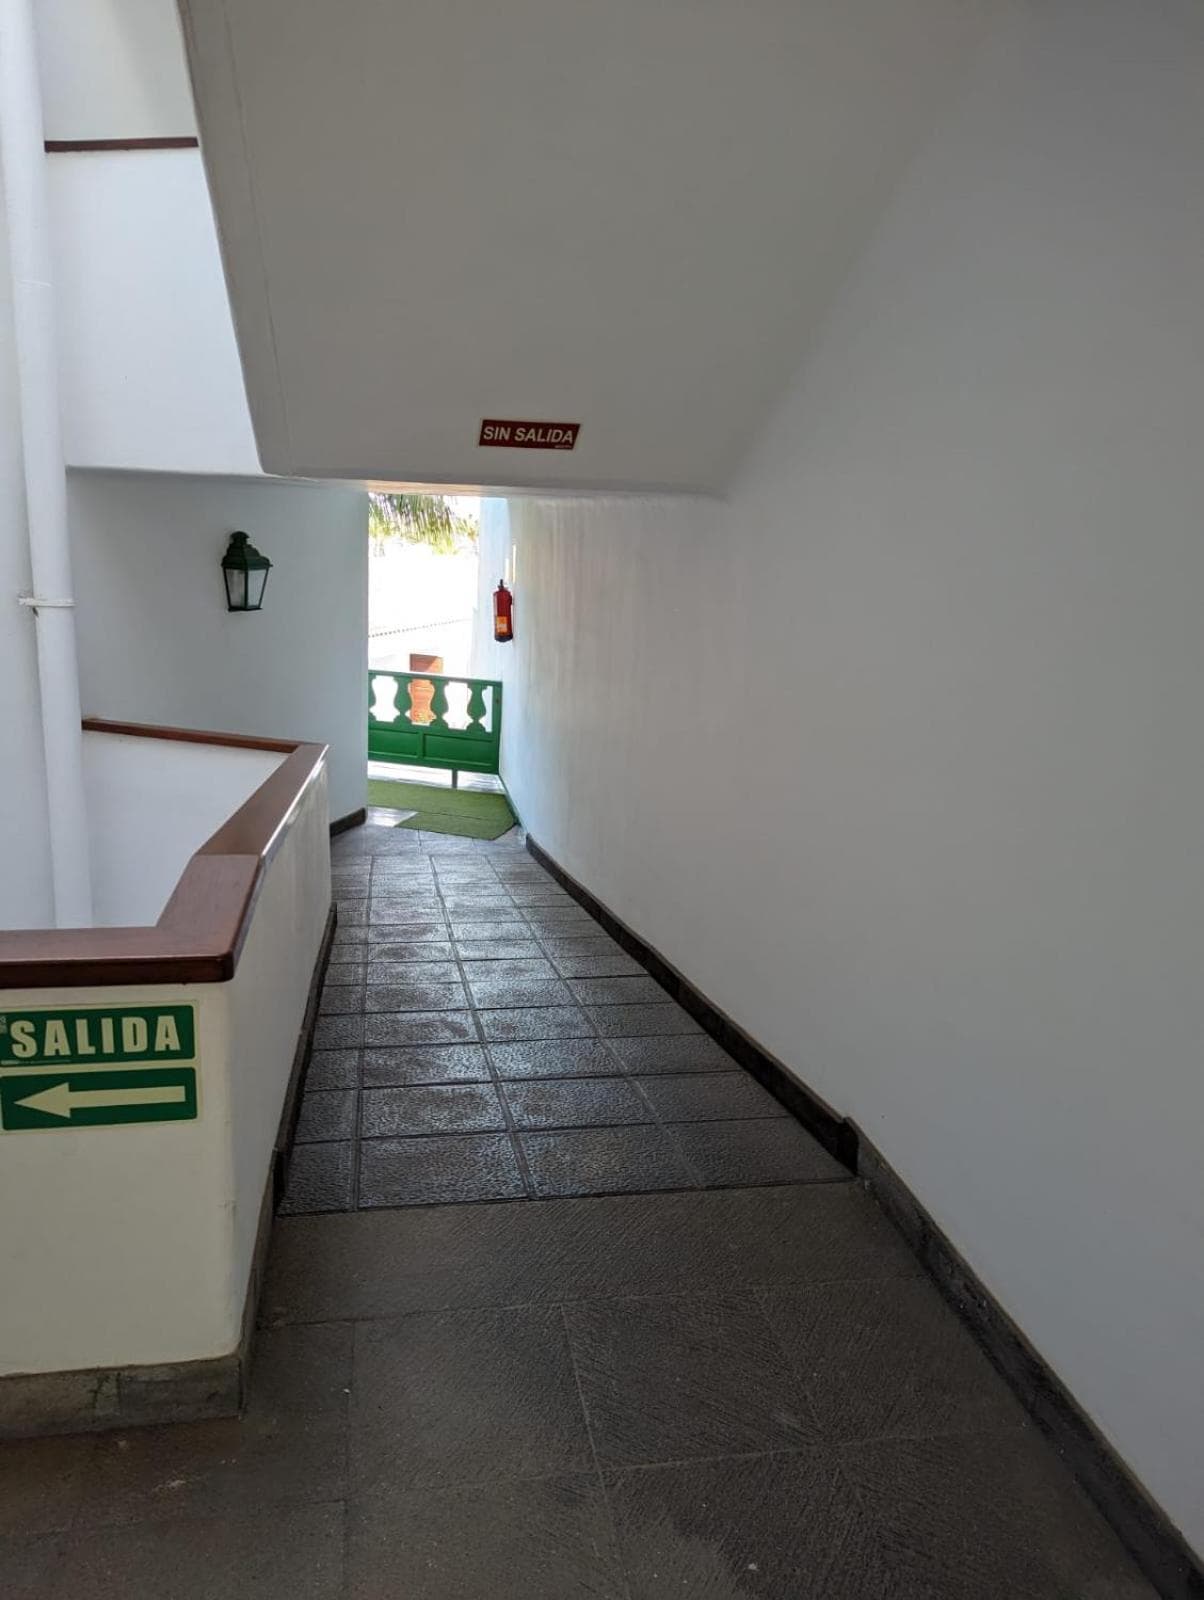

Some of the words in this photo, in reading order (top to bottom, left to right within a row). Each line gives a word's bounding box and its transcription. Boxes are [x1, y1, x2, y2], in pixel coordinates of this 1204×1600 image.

[483, 426, 511, 440] SIN
[514, 427, 573, 443] SALIDA
[10, 1015, 181, 1058] SALIDA
